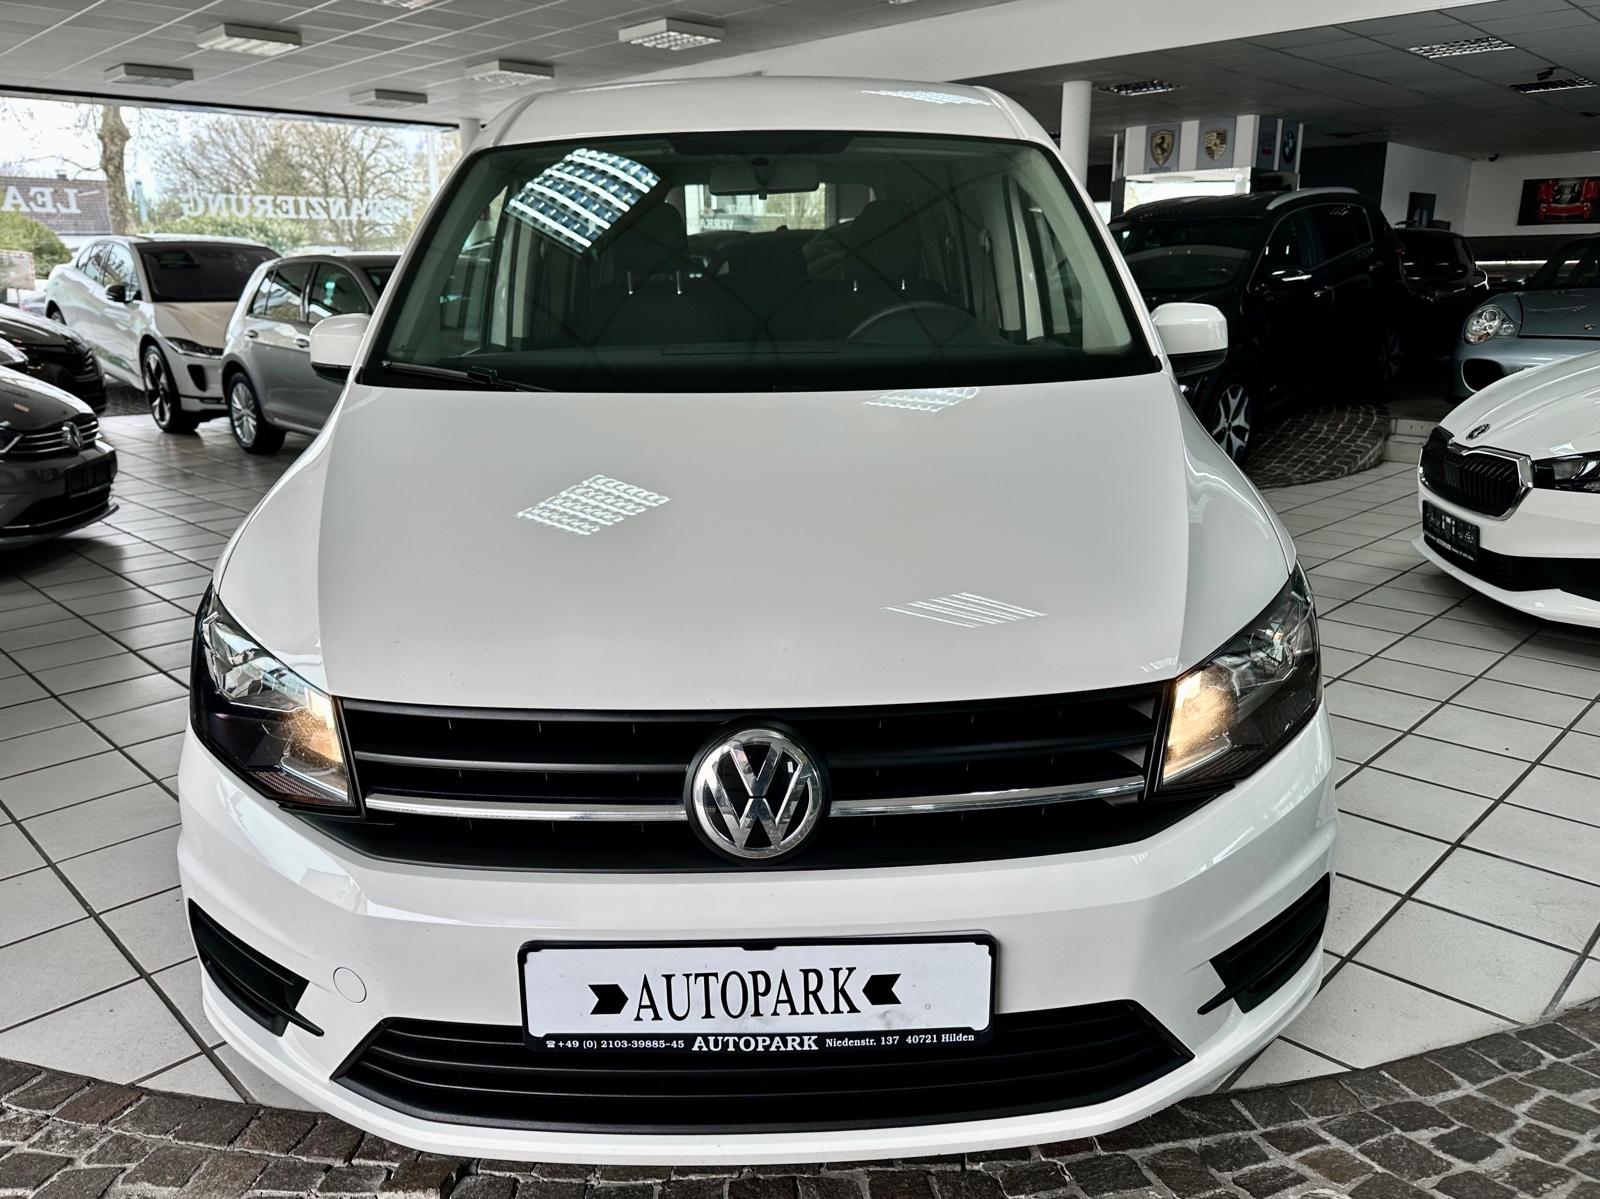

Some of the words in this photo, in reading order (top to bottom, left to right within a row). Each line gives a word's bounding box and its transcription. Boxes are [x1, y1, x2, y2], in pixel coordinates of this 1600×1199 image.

[634, 966, 861, 1021] AUTOPARK
[557, 1039, 580, 1049] +49
[583, 1039, 598, 1050] (0)
[600, 1039, 686, 1049] 2103-39885-45
[692, 1035, 819, 1052] AUTOPARK
[825, 1037, 877, 1048] Niedenstr.
[880, 1035, 900, 1046] 137
[905, 1034, 938, 1044] 40721
[941, 1033, 975, 1043] Hilden
